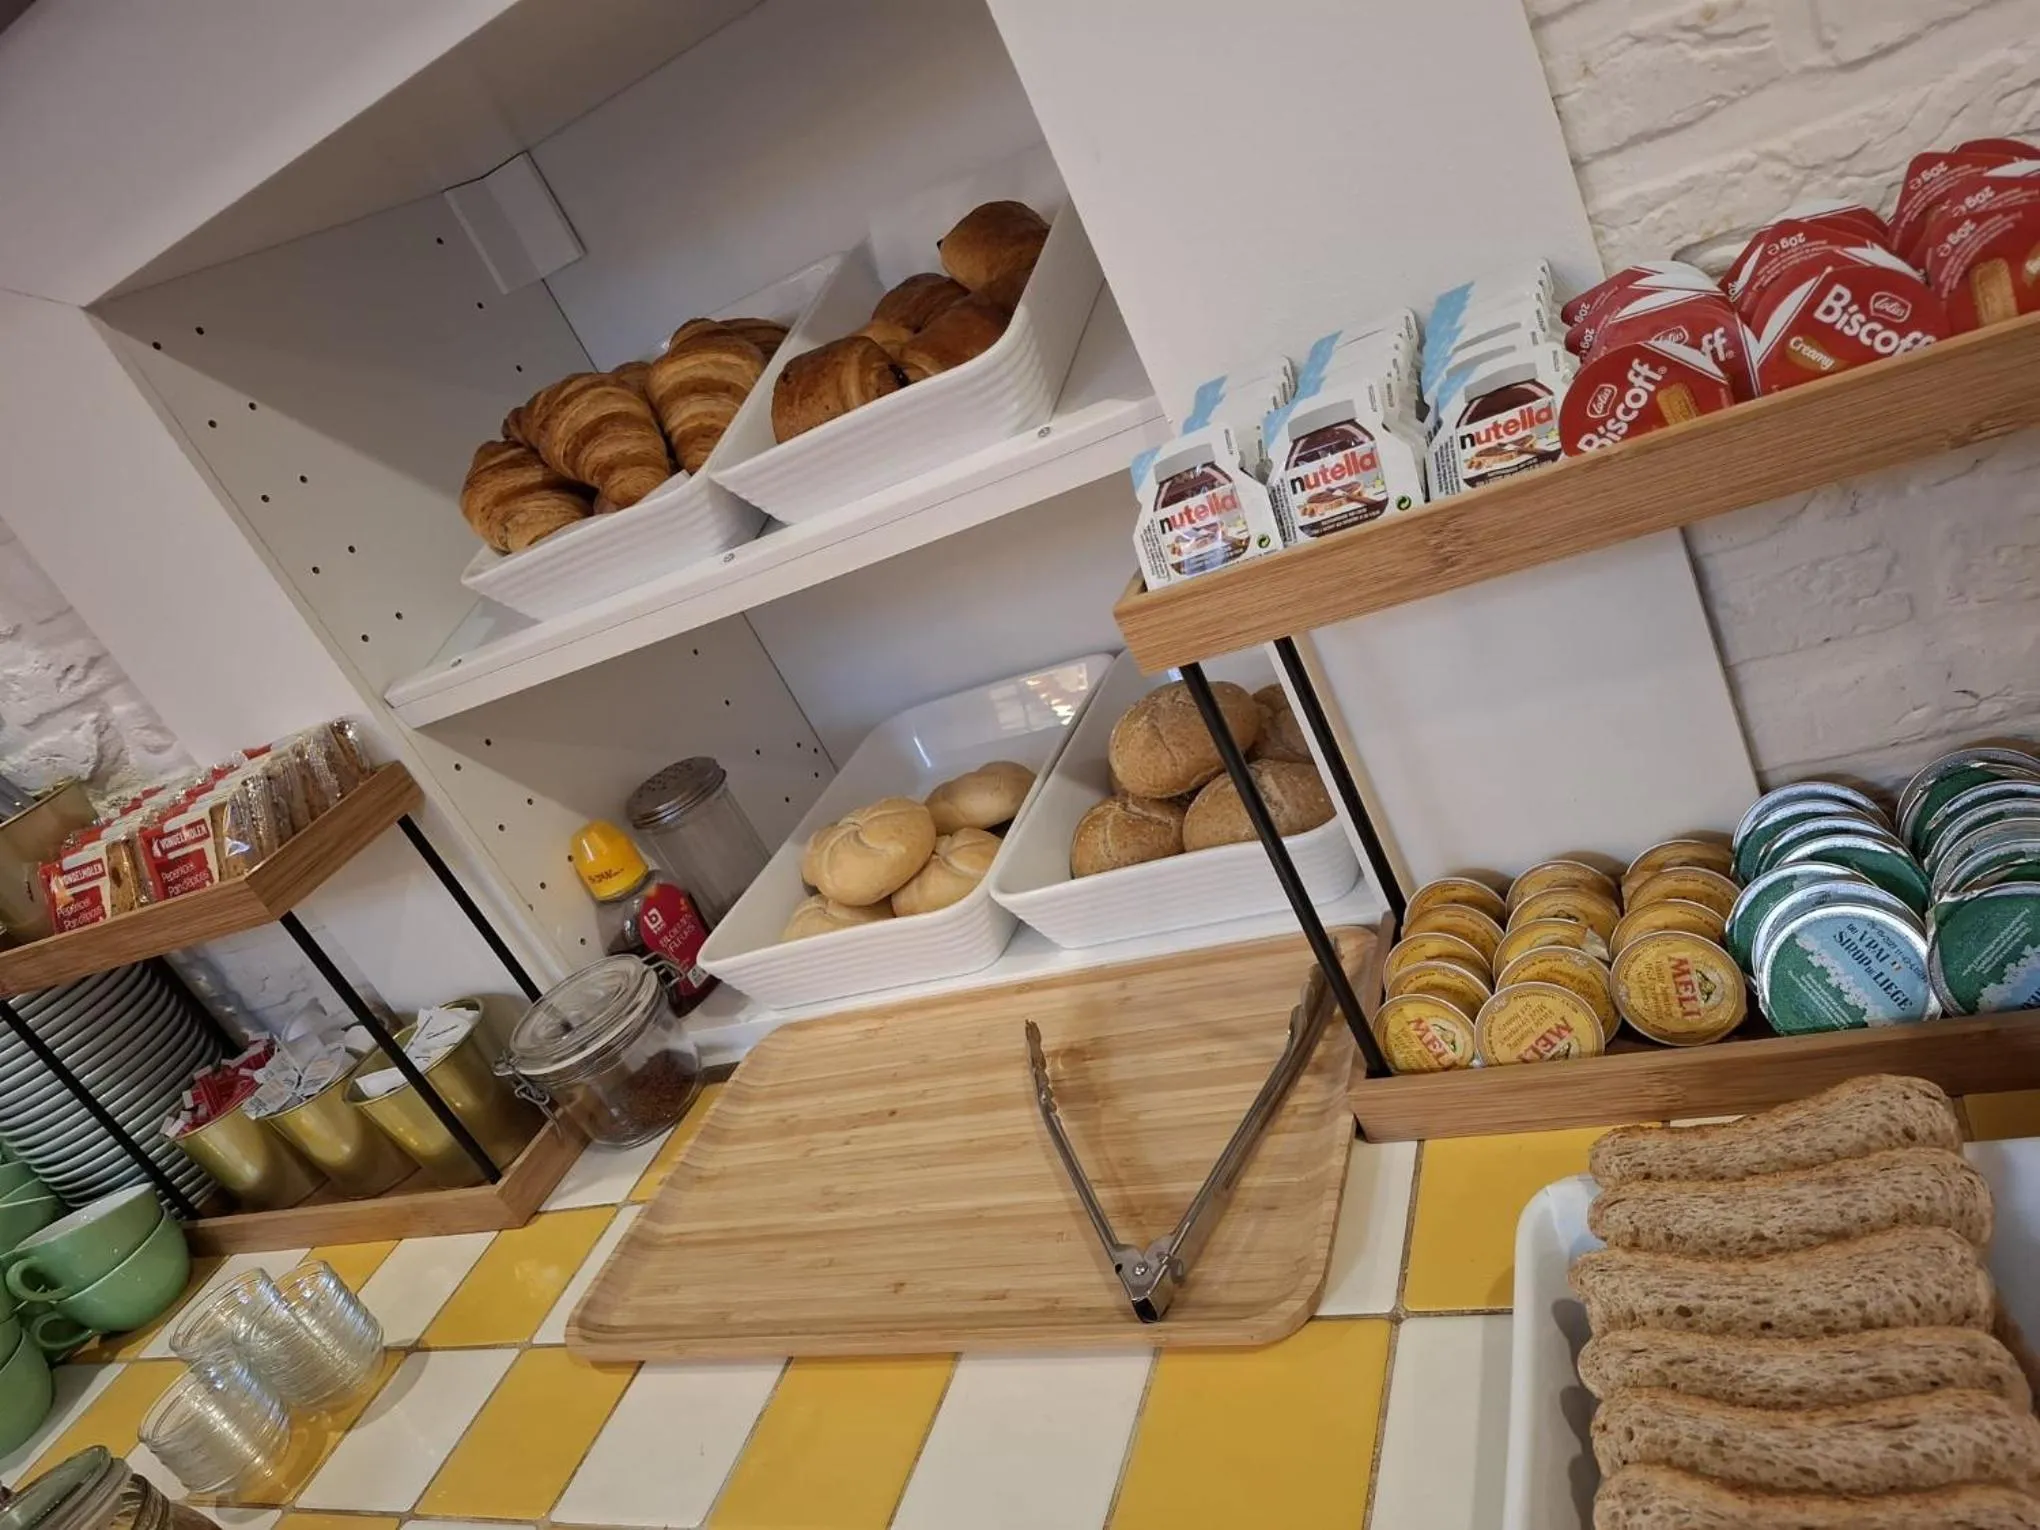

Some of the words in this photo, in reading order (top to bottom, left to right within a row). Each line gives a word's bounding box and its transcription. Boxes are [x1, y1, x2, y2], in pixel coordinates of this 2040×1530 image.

[1780, 232, 1806, 250] 20g
[1789, 336, 1836, 370] Creamy
[1592, 388, 1613, 416] Lotus
[1460, 406, 1554, 449] nutella
[1290, 449, 1379, 495] nutella
[1159, 490, 1240, 534] nutella
[1833, 930, 1872, 971] SIROP
[1858, 930, 1892, 964] VRAI
[1668, 957, 1702, 1018] MELI
